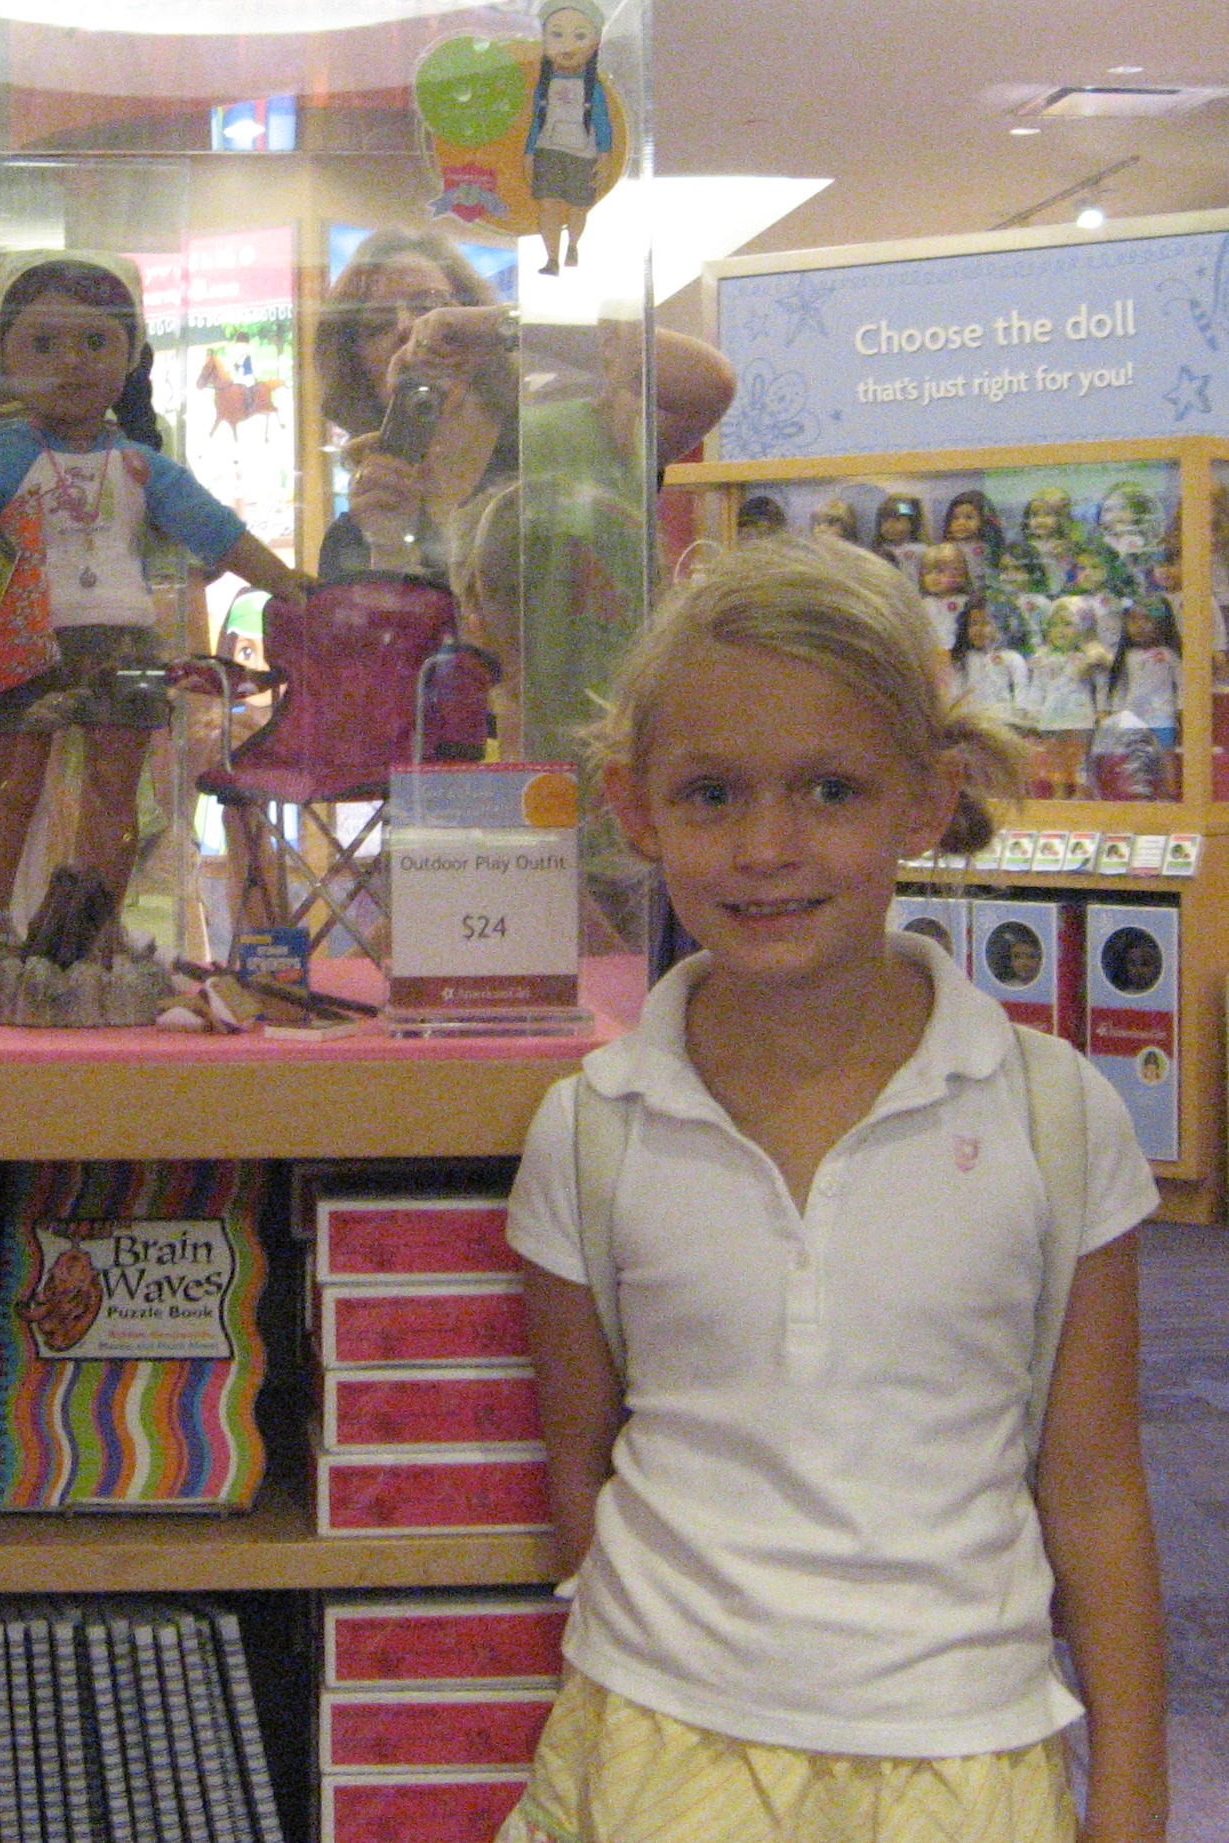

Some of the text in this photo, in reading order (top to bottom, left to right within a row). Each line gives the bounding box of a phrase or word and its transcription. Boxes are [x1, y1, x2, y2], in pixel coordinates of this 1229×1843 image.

[854, 299, 1137, 356] Choose the doll
[856, 361, 1136, 407] that's just right for you!
[400, 854, 567, 874] Outdoor Play Outfit
[462, 915, 507, 941] $24
[112, 1229, 214, 1267] Brain
[101, 1268, 223, 1304] Waves
[106, 1305, 213, 1319] Puzzle Book
